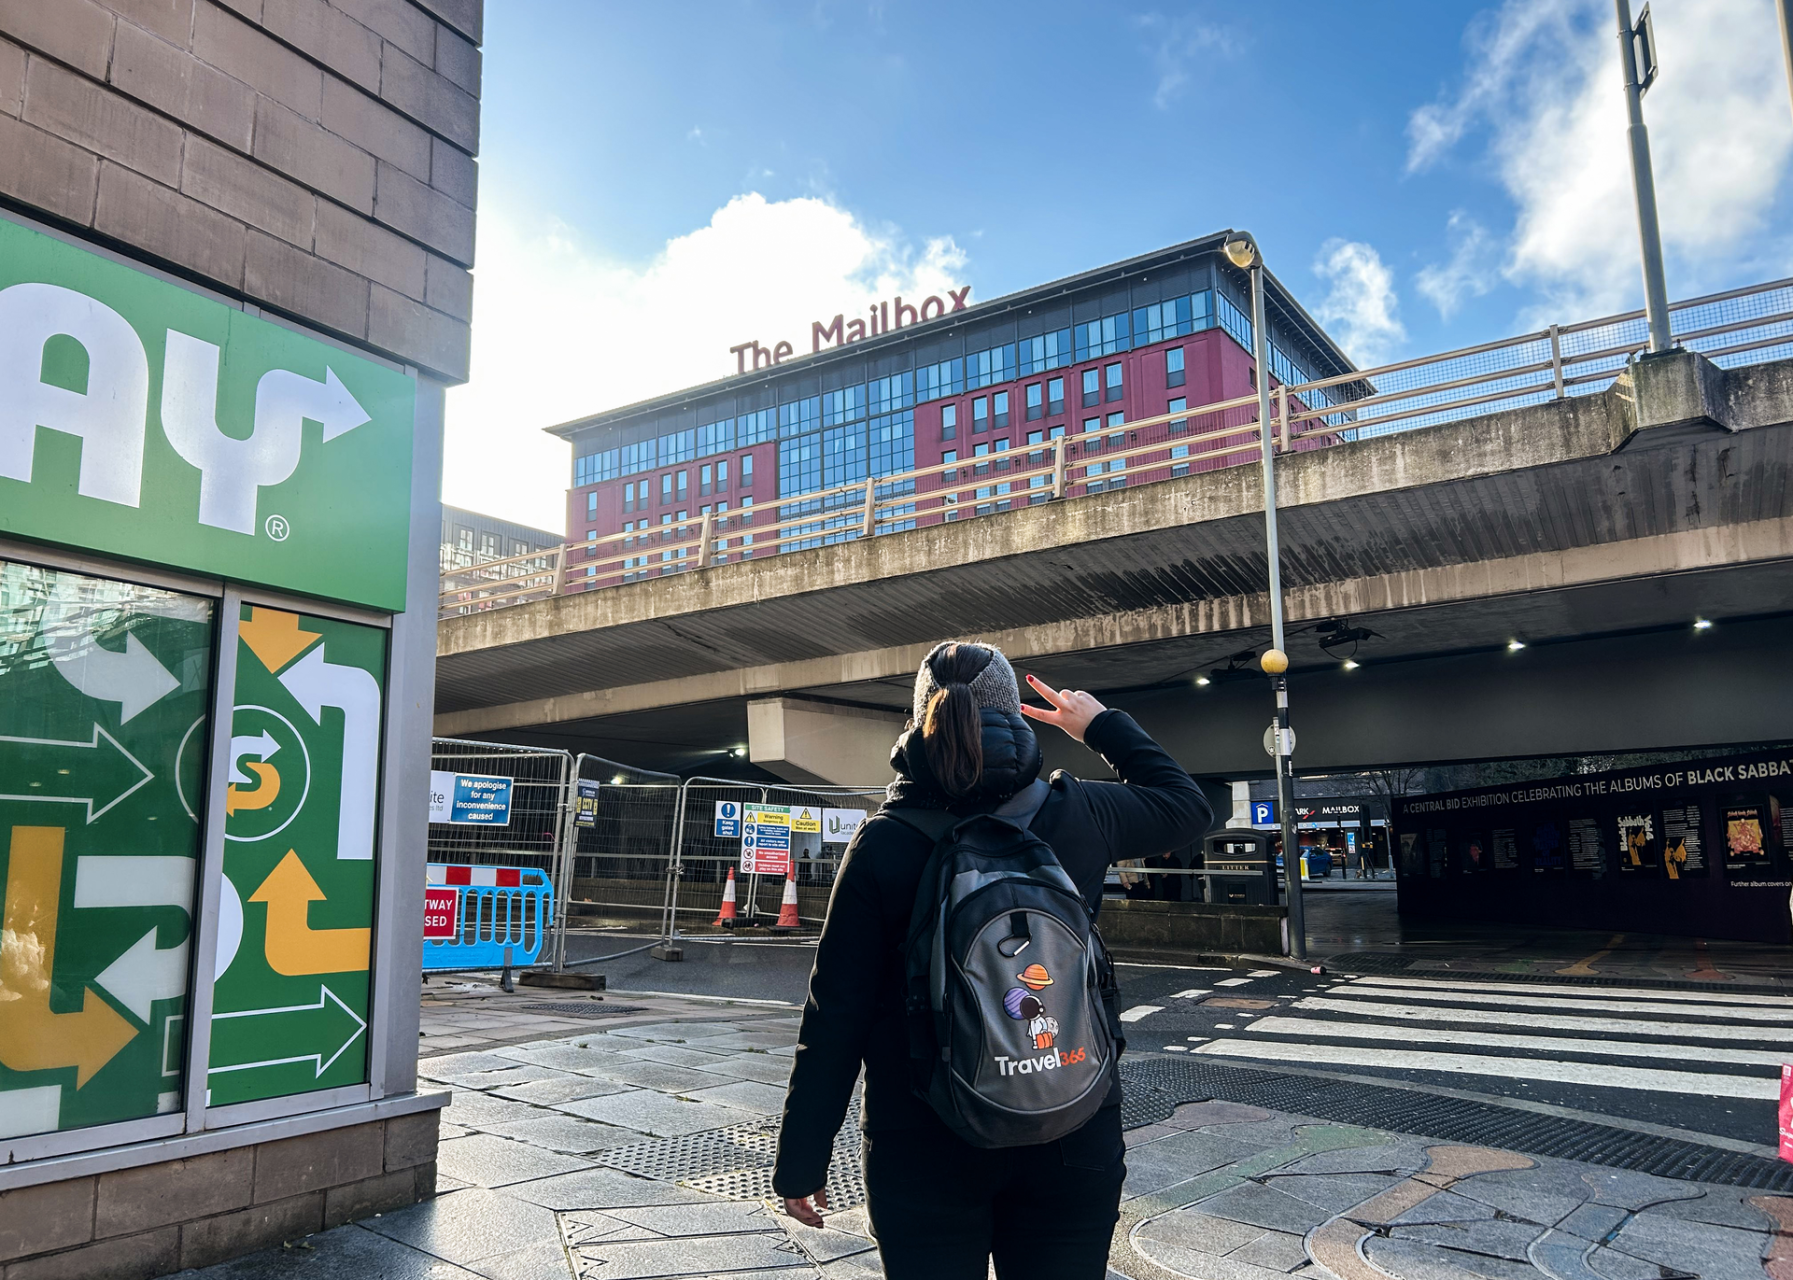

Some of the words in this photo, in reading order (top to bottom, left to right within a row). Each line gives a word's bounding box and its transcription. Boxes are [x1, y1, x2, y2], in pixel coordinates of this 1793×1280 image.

[729, 340, 794, 375] The
[812, 285, 972, 352] Mailbox
[460, 779, 472, 788] We
[473, 780, 507, 790] apologise
[1403, 804, 1410, 814] A
[1409, 800, 1445, 814] CENTRAL
[1446, 799, 1461, 810] BID
[1462, 792, 1510, 809] EXHIBITION
[1511, 784, 1582, 803] CELEBRATING
[1584, 781, 1607, 795] THE
[1609, 774, 1662, 793] ALBUMS
[1665, 772, 1684, 787] OF
[1687, 766, 1735, 785] BLACK
[470, 790, 481, 799] for
[482, 792, 496, 801] any
[456, 799, 507, 811] inconvenience
[1322, 805, 1360, 815] MAILBOX
[467, 811, 494, 821] caused
